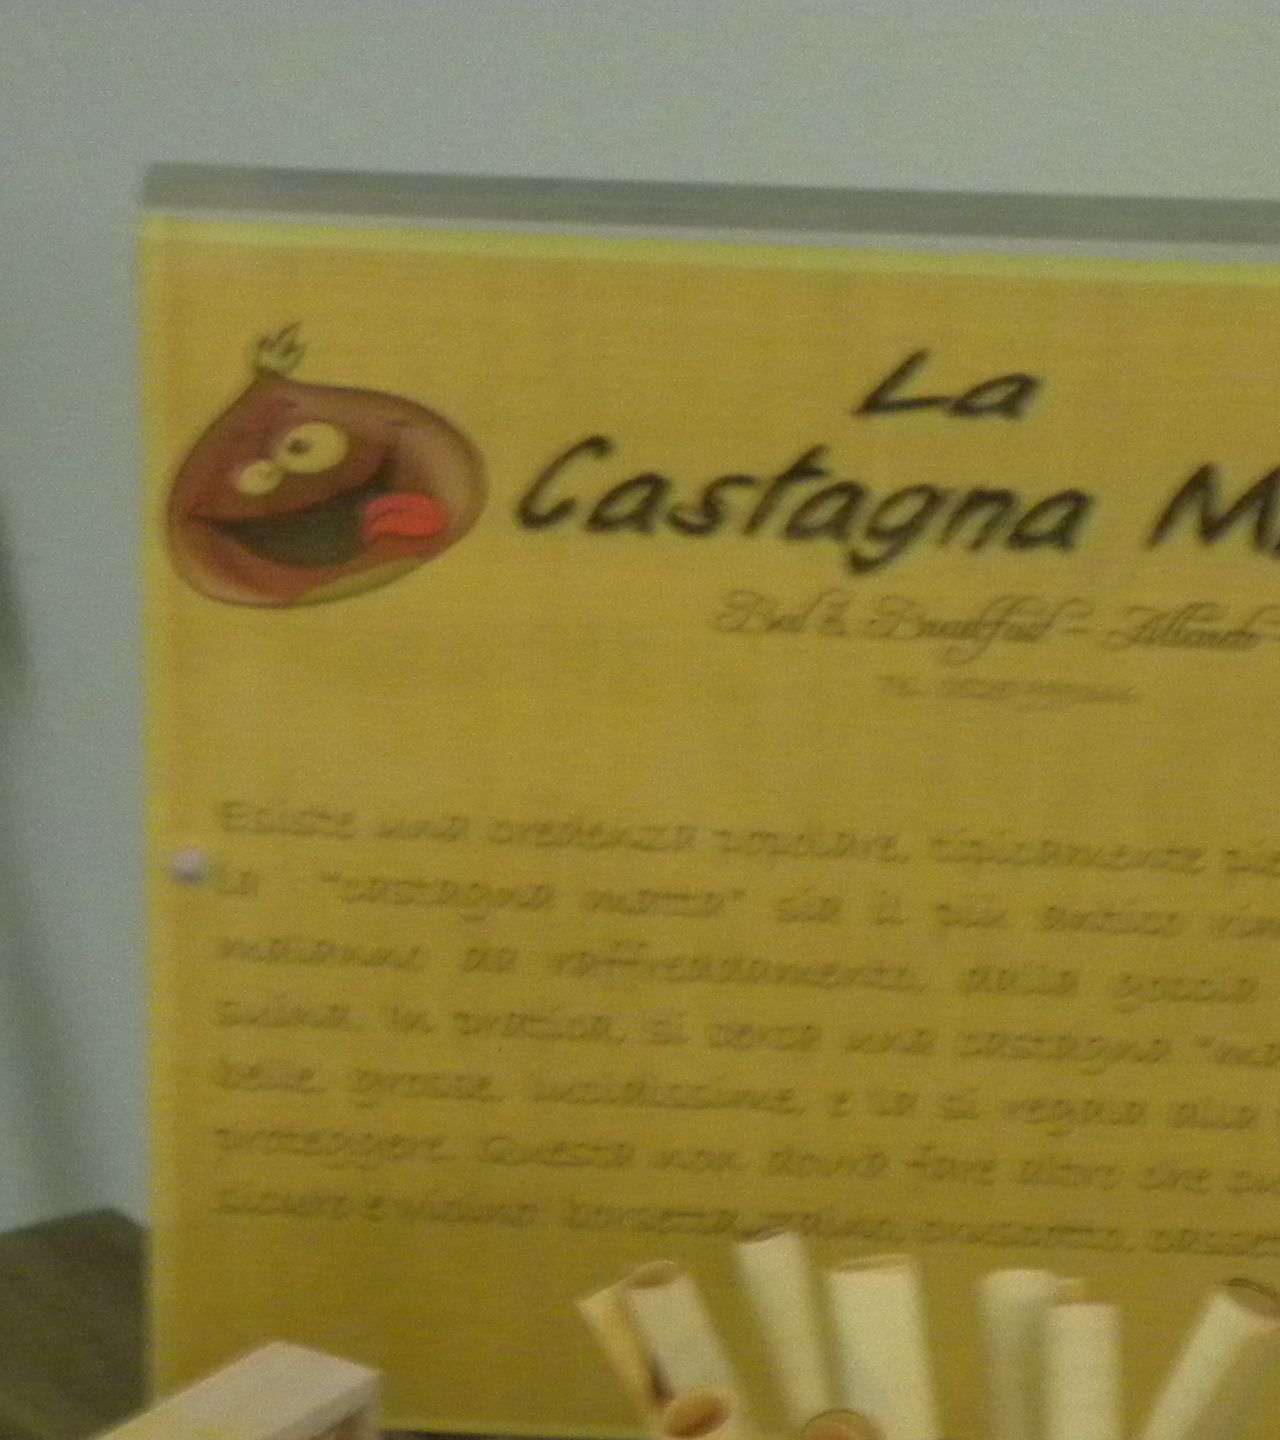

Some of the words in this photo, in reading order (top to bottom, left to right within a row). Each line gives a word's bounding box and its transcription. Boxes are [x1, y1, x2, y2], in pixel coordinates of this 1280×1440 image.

[854, 348, 1042, 422] La
[517, 435, 1095, 575] Castagna
[217, 800, 356, 839] Esiste
[376, 815, 472, 842] una
[487, 815, 697, 853] credenza
[927, 828, 1206, 878] tipicamente
[772, 889, 844, 924] sia
[1034, 904, 1184, 939] antico
[642, 1009, 690, 1045] si
[704, 1021, 826, 1053] cerca
[841, 1027, 937, 1057] una
[955, 1030, 1176, 1078] castagna
[1000, 1097, 1148, 1139] regala
[1166, 1096, 1261, 1132] alla
[475, 1132, 637, 1169] Questa
[903, 1144, 999, 1187] fare
[1015, 1153, 1122, 1190] altro
[1136, 1160, 1214, 1194] che
